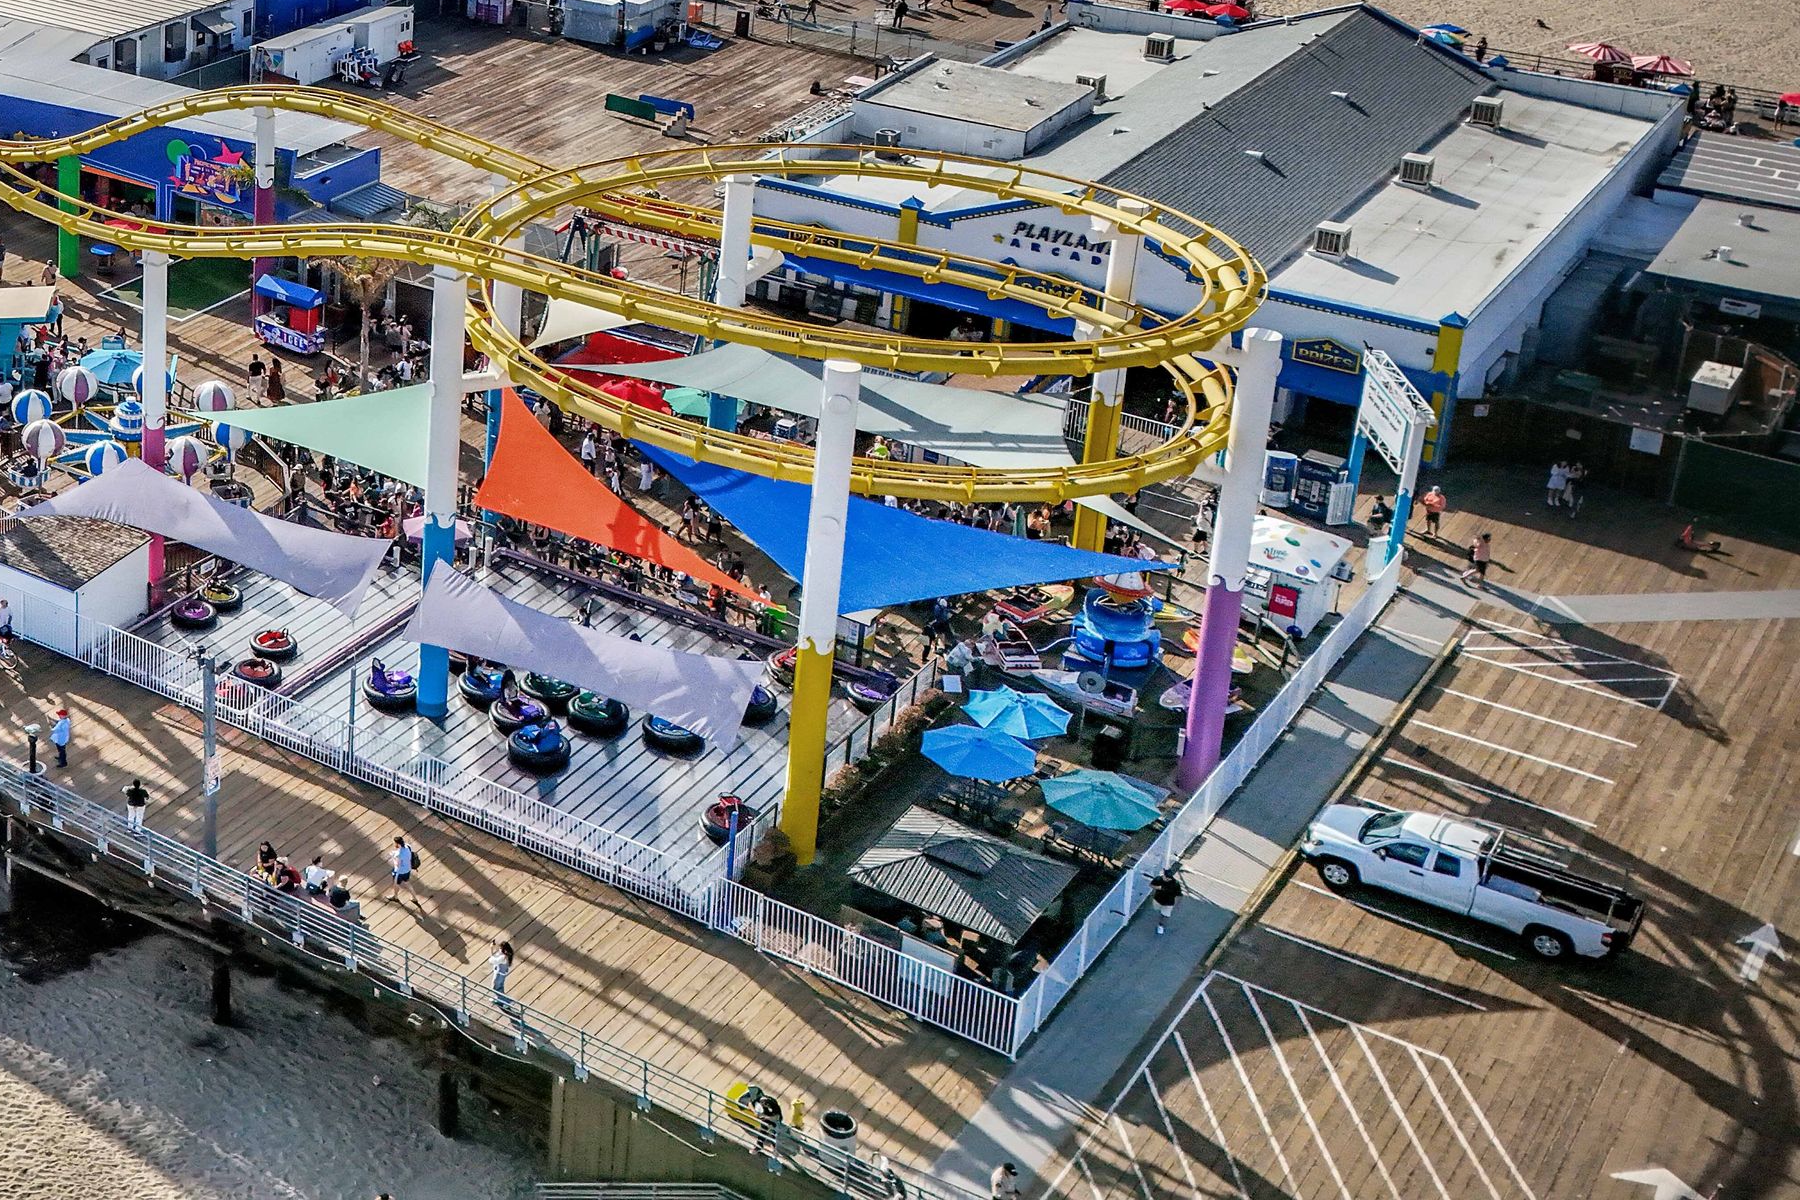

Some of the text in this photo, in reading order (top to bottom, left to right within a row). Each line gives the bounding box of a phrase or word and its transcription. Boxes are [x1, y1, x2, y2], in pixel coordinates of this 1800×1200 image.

[793, 231, 835, 247] PRZES
[1012, 221, 1110, 255] PLAYLAN
[1010, 238, 1102, 266] ARCAD
[283, 332, 304, 348] ICEE
[1299, 348, 1354, 366] PRIZES
